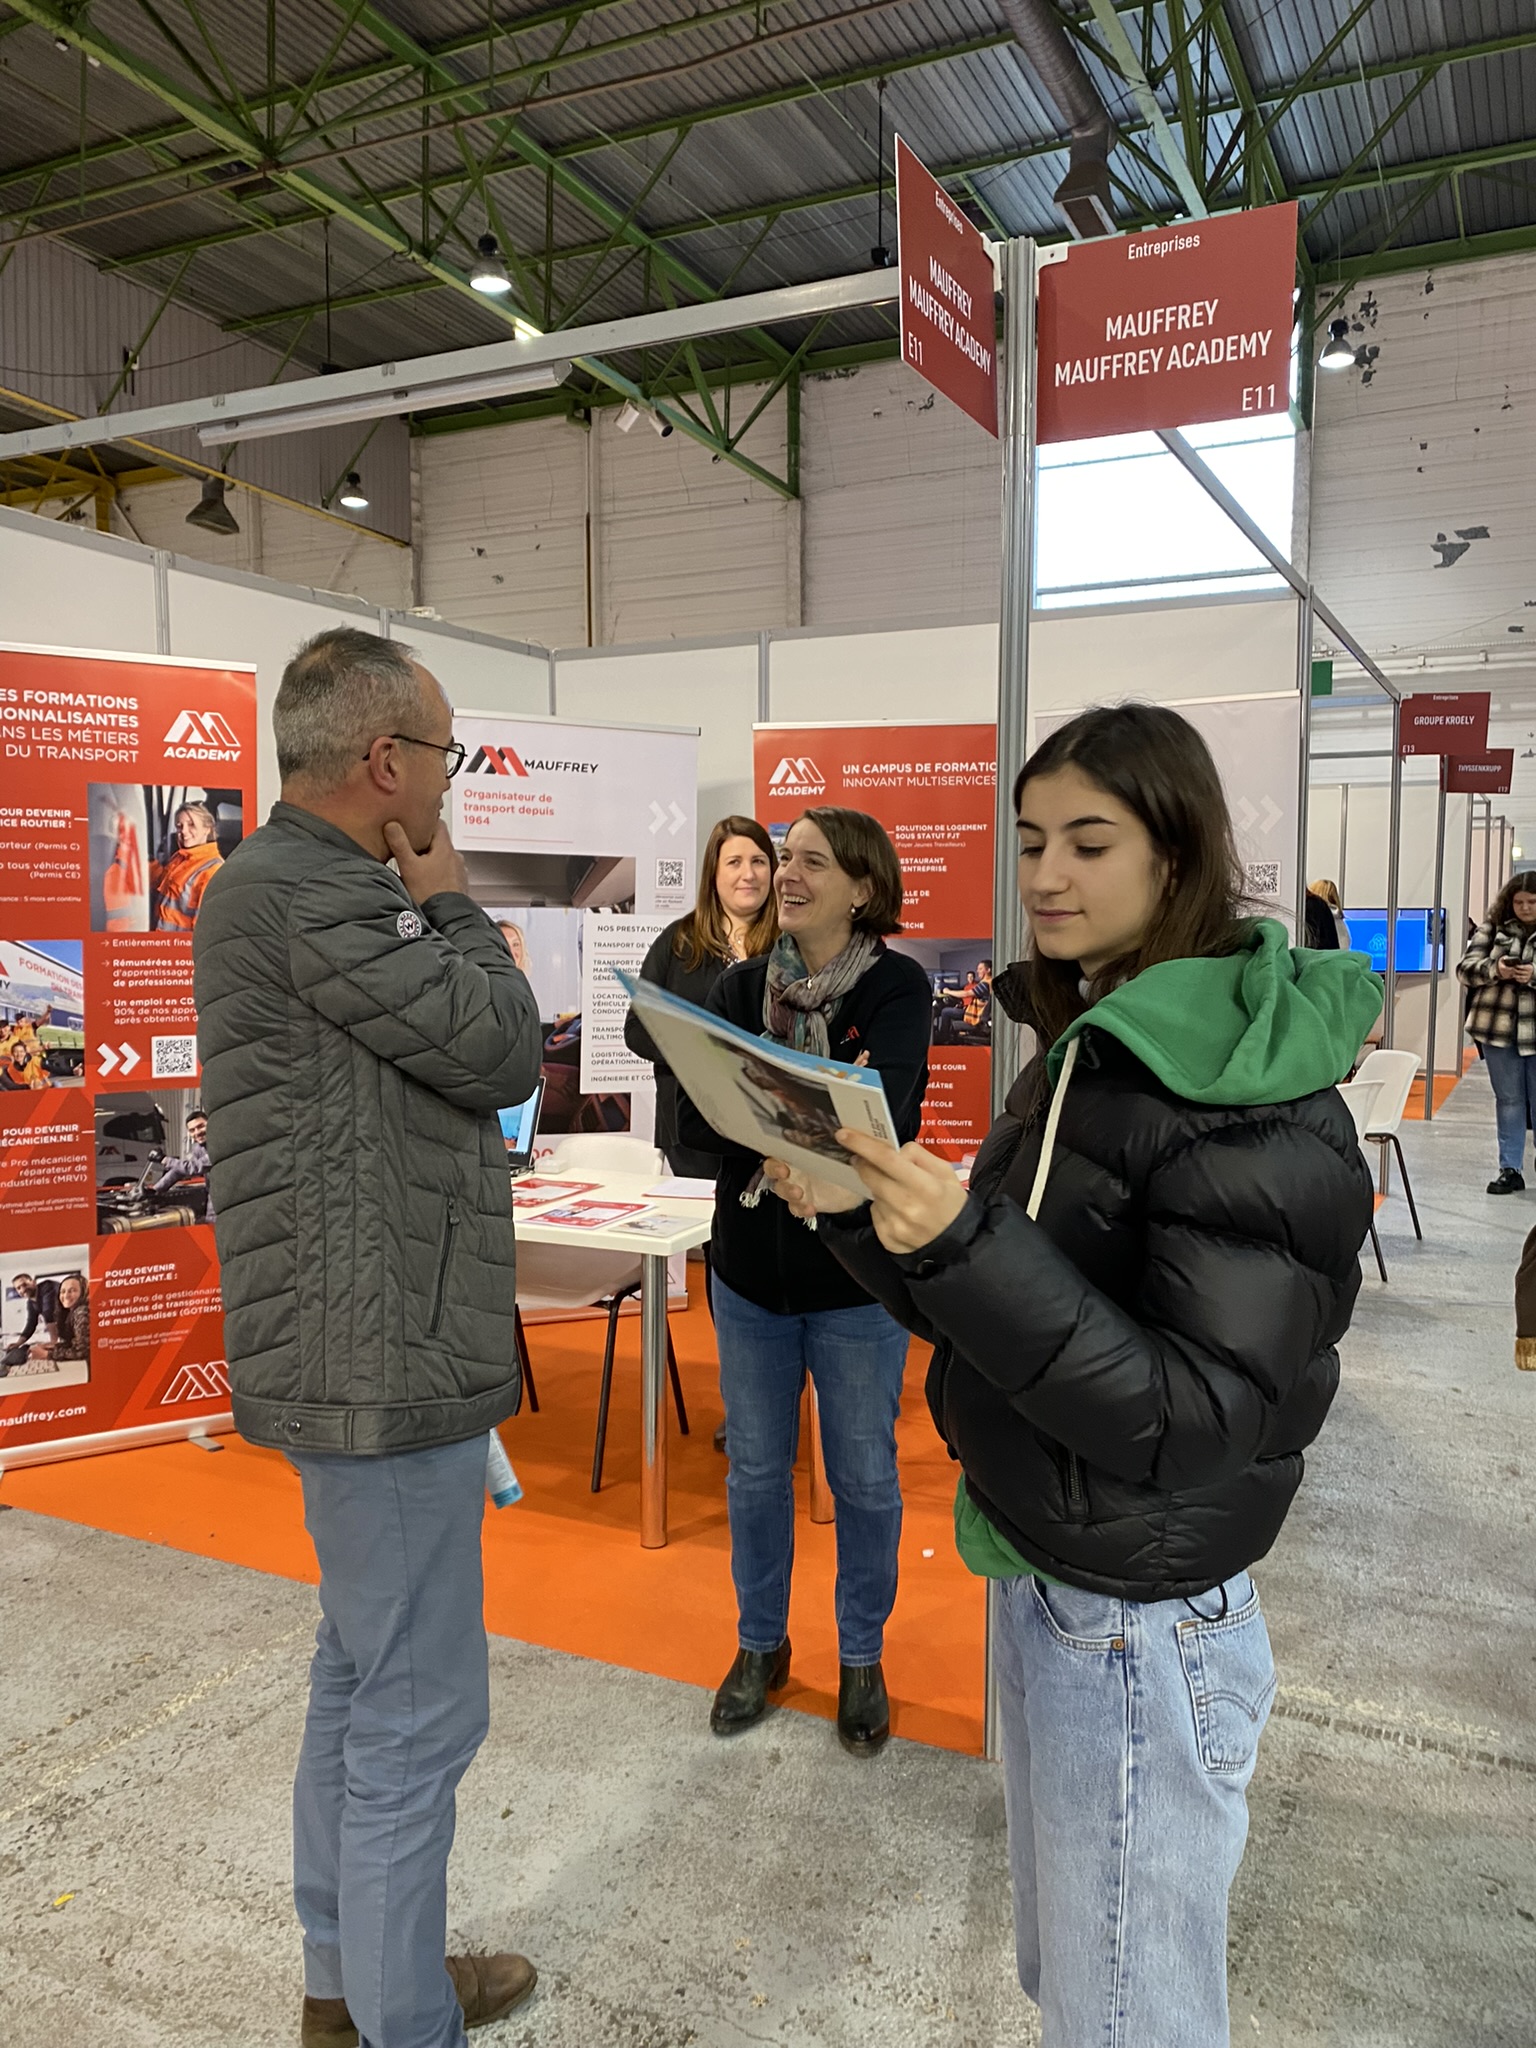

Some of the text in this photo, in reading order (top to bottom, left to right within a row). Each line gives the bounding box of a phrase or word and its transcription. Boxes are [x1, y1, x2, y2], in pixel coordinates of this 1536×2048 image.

[935, 190, 963, 234] Entreprises
[1128, 234, 1200, 260] Entreprises
[929, 255, 972, 320] MAUFFREY
[909, 275, 991, 376] MAUFFREY ACADEMY
[1105, 299, 1219, 342] MAUFFREY
[908, 331, 923, 366] E11
[1054, 329, 1272, 387] MAUFFREY ACADEMY
[1241, 384, 1276, 412] E11
[23, 690, 139, 710] FORMATIONS
[1414, 715, 1475, 725] GROUPE KROELY
[0, 725, 139, 746] NS LES MÉTIERS
[5, 744, 139, 763] DU TRANSPORT
[163, 746, 241, 762] ACADEMY
[1402, 744, 1415, 753] E13
[524, 759, 599, 774] MAUFFREY
[842, 764, 860, 774] UN
[863, 763, 912, 773] CAMPUS
[915, 763, 931, 773] DE
[842, 775, 997, 787] INNOVANT MULTISERVICES
[463, 789, 553, 804] Organisateur de
[768, 785, 826, 797] ACADEMY
[25, 808, 72, 818] DEVENIR
[463, 802, 555, 818] transport depuis
[20, 819, 66, 829] ROUTIER
[463, 815, 491, 826] 1964
[34, 842, 68, 850] (Permis
[69, 842, 80, 851] C)
[7, 861, 30, 870] tous
[33, 861, 81, 870] véhicules
[29, 871, 81, 879] (Permis CE)
[616, 925, 665, 933] PRESTATION
[112, 938, 171, 947] Entièrement
[112, 958, 172, 967] Rémunérées
[19, 957, 70, 984] FORMATION
[112, 969, 189, 977] d'apprentissage
[112, 979, 126, 987] de
[113, 999, 127, 1007] Un
[129, 997, 162, 1007] emploi
[113, 1007, 135, 1016] 90%
[137, 1007, 150, 1015] de
[113, 1016, 141, 1025] après
[143, 1014, 190, 1023] obtention
[591, 1074, 629, 1082] INGÉNIERIE
[2, 1124, 79, 1137] POUR DEVENIR
[0, 1134, 74, 1147] ÉCANICIEN.NE
[10, 1158, 28, 1167] Pro
[31, 1155, 87, 1166] mécanicien
[19, 1164, 88, 1177] réparateur de
[52, 1174, 88, 1184] (MRVI)
[105, 1263, 175, 1279] POUR DEVENIR
[105, 1273, 173, 1288] EXPLOITANT.E
[108, 1287, 222, 1307] Titre Pro de gestionnaire
[98, 1304, 149, 1318] opérations
[151, 1302, 163, 1310] de
[165, 1297, 209, 1309] transport
[98, 1318, 110, 1327] de
[113, 1310, 177, 1325] marchandises
